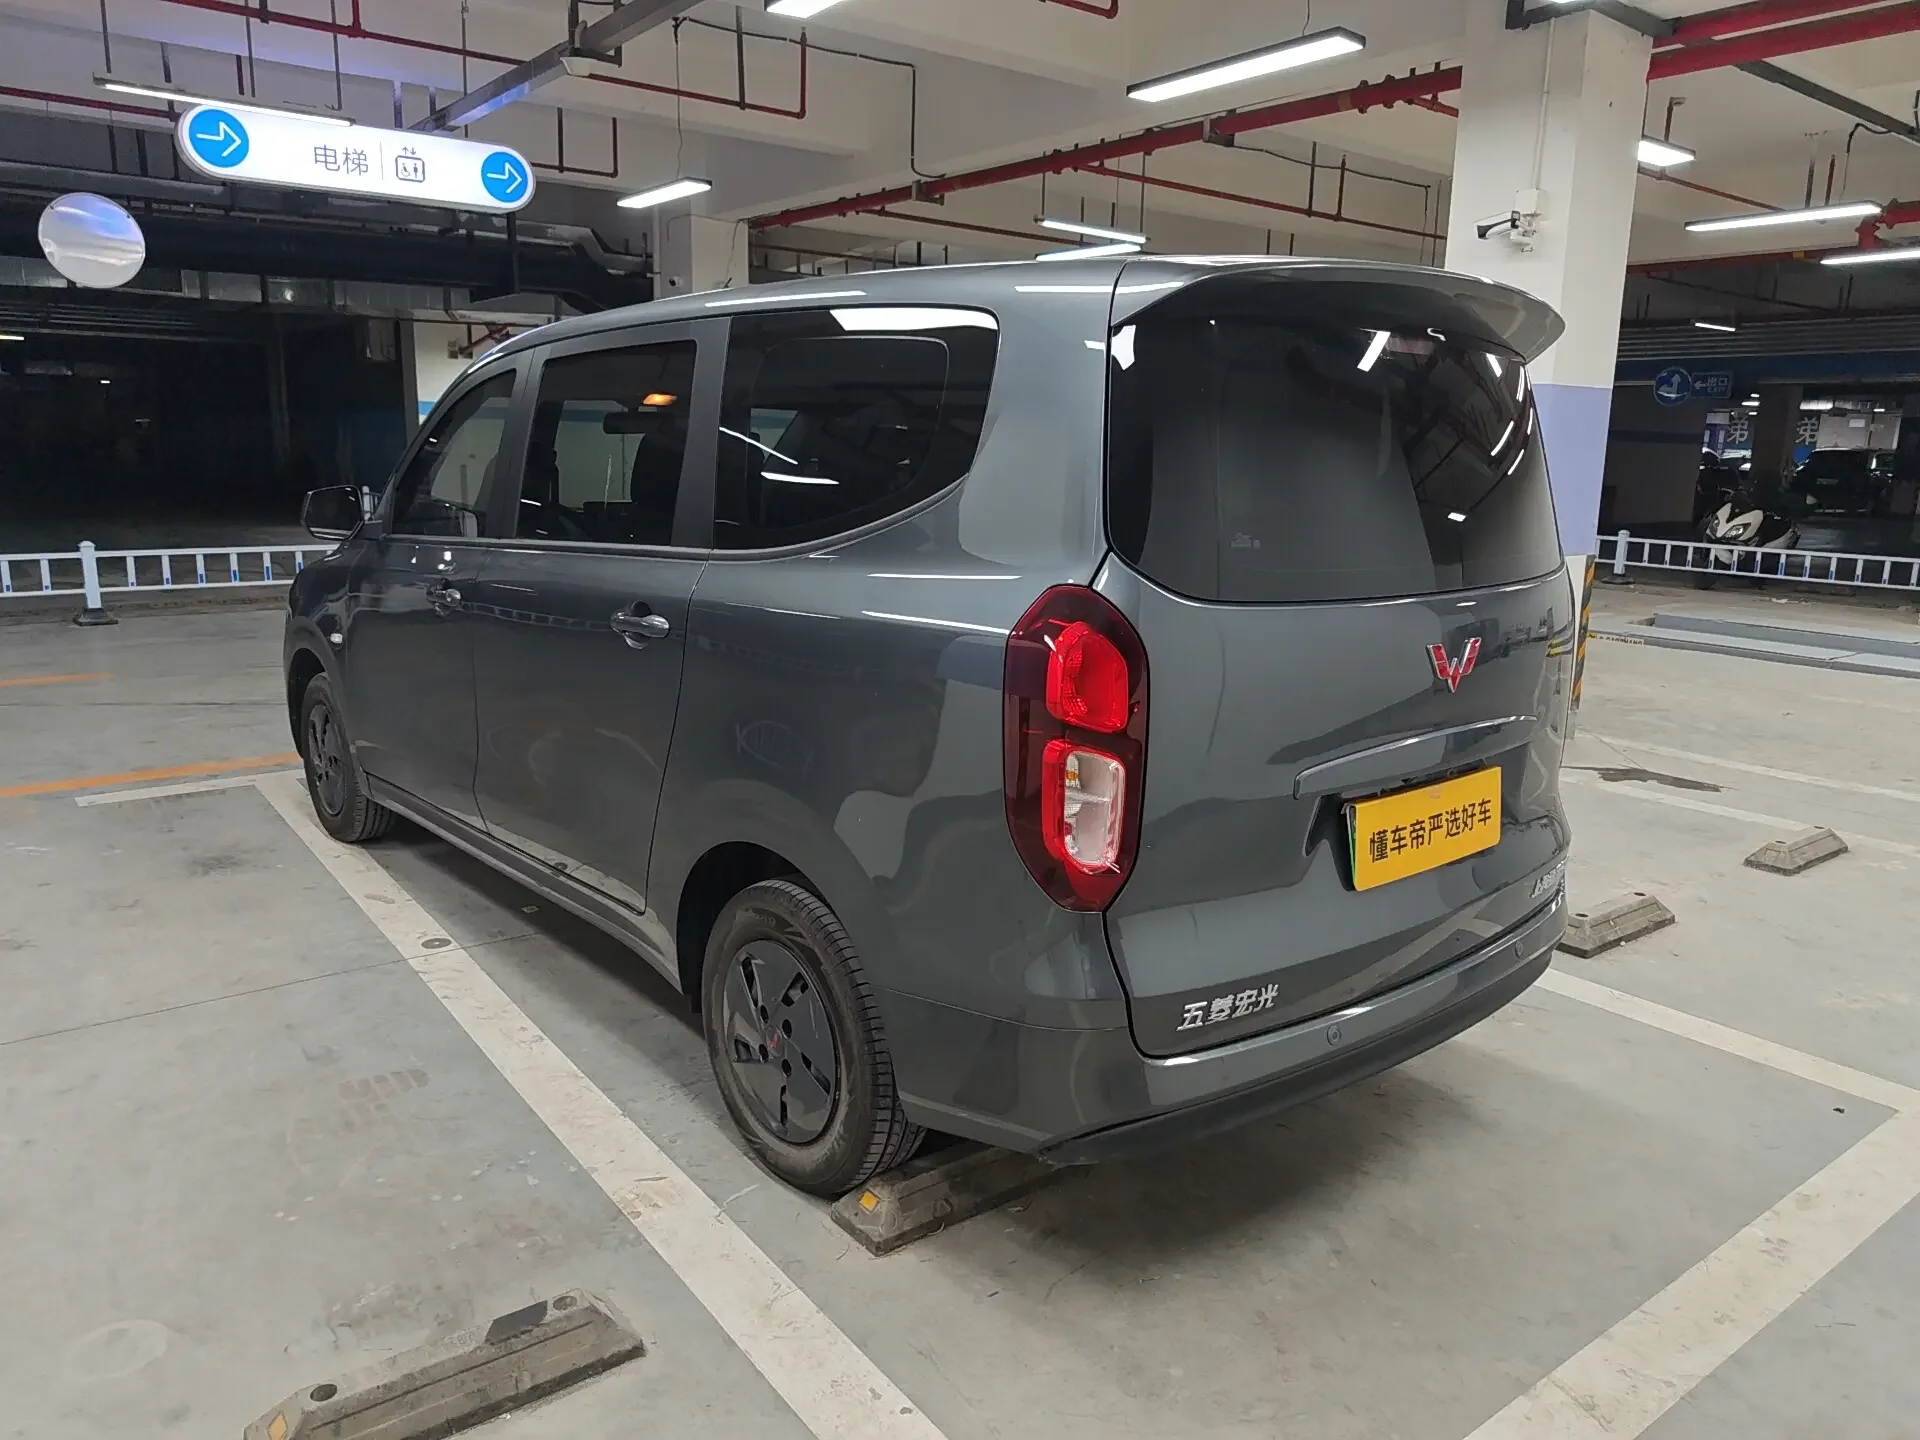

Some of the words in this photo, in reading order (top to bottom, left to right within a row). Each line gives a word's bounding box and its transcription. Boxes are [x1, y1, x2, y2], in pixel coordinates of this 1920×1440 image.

[313, 144, 369, 176] 电梯
[1707, 376, 1728, 387] 出口
[1369, 798, 1492, 863] 懂车帝严选好车
[1176, 984, 1279, 1031] 五菱宏光
